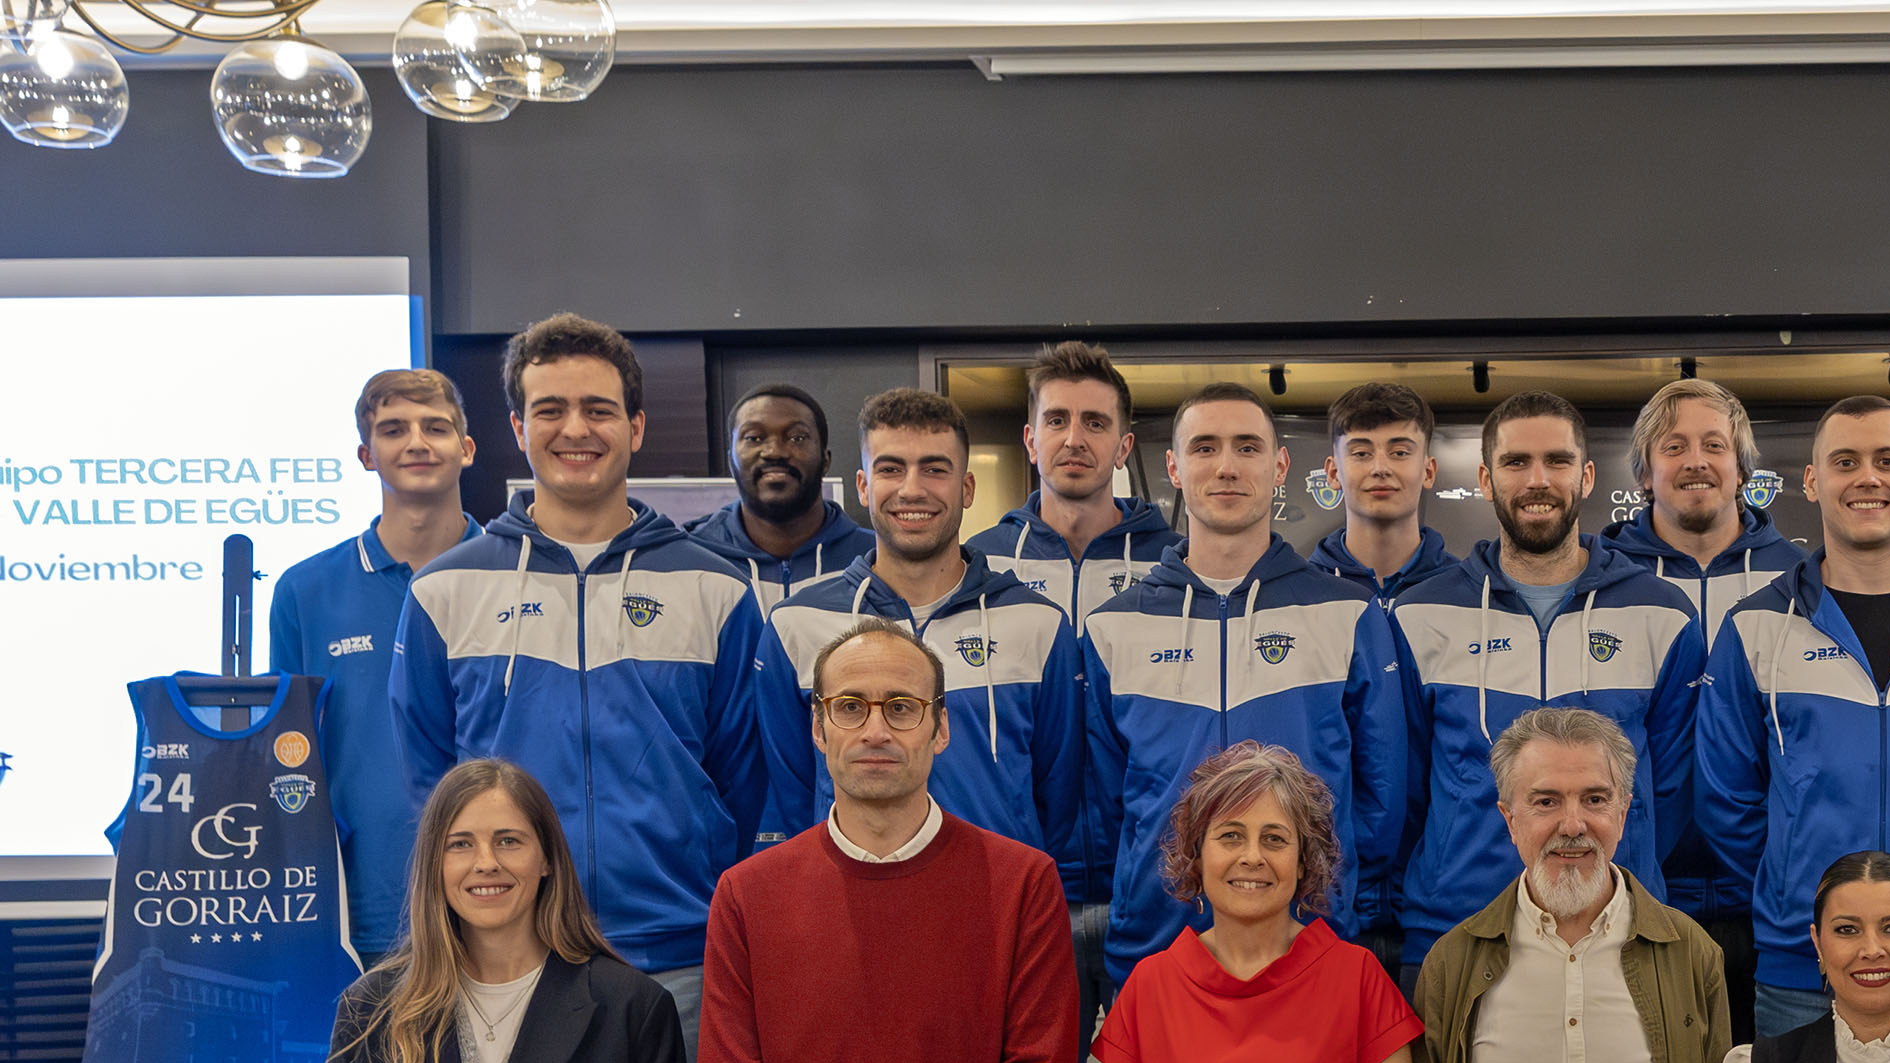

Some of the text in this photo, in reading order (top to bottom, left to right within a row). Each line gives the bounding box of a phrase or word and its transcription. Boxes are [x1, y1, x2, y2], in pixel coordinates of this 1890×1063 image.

[0, 457, 343, 492] ipo TERCERA FEB
[12, 489, 341, 525] VALLE DE EGÜES
[0, 553, 204, 582] oviembre
[341, 634, 374, 653] BZK
[1817, 646, 1847, 658] BZK
[157, 744, 189, 755] BZK
[138, 773, 194, 813] 24
[135, 866, 317, 892] CASTILLO DE
[134, 893, 318, 927] GORRAIZ
